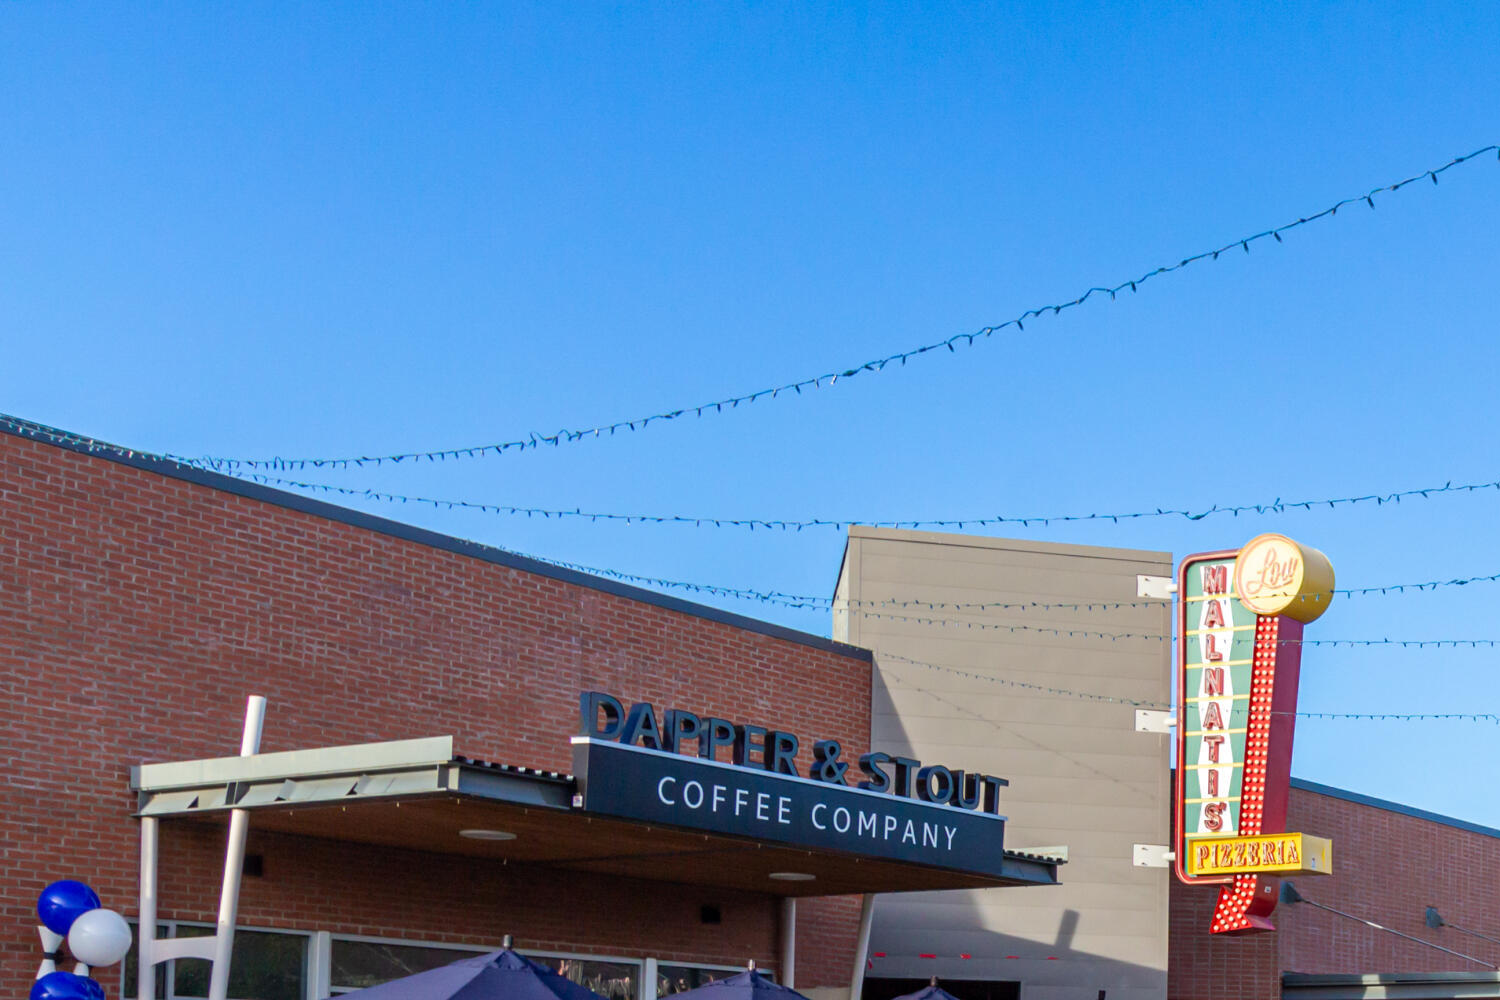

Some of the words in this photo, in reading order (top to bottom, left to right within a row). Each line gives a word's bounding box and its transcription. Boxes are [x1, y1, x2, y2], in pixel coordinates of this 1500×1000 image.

[580, 692, 799, 777] DAPPER
[810, 740, 849, 786] &
[858, 752, 1009, 815] STOUT
[657, 775, 793, 825] COFFEE
[811, 803, 958, 850] COMPANY
[1196, 840, 1300, 870] PIZZERIA
